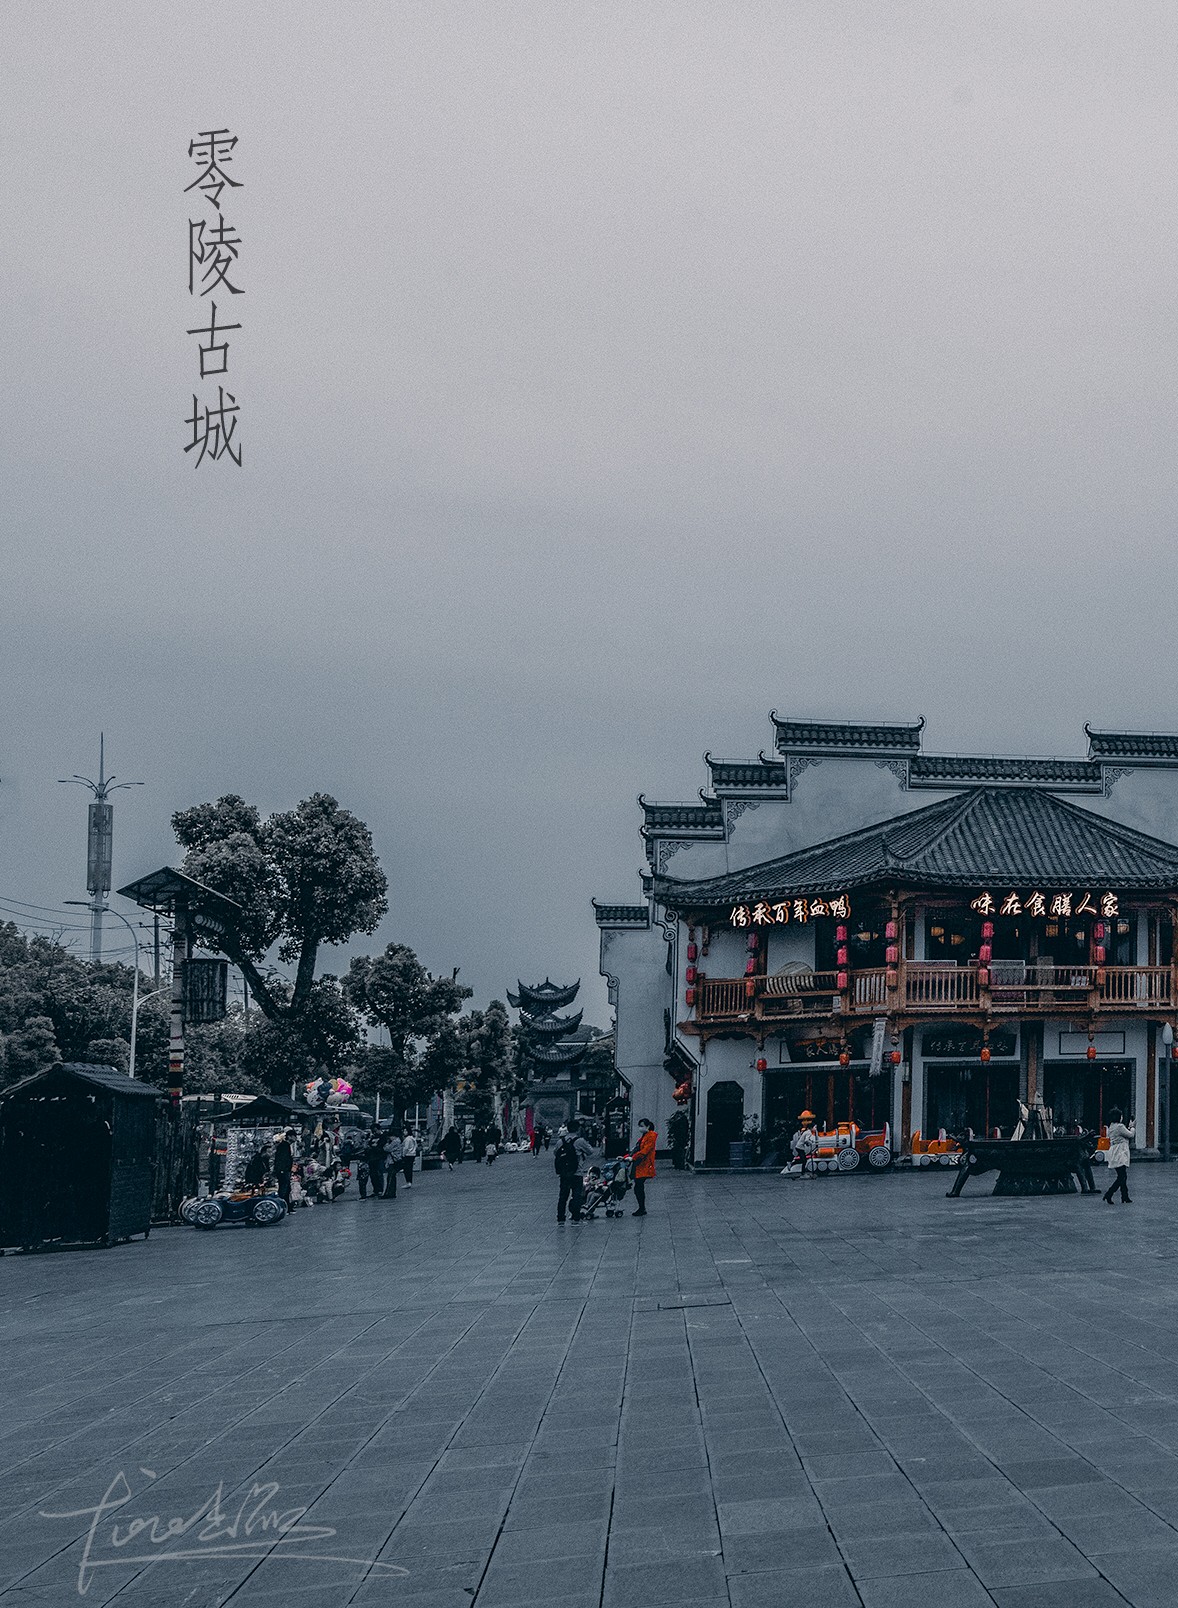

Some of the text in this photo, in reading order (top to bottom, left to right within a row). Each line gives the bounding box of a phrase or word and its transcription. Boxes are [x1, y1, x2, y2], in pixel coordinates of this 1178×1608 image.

[729, 893, 852, 928] 传承百年血鸭
[970, 890, 1120, 917] 味在食膳人家
